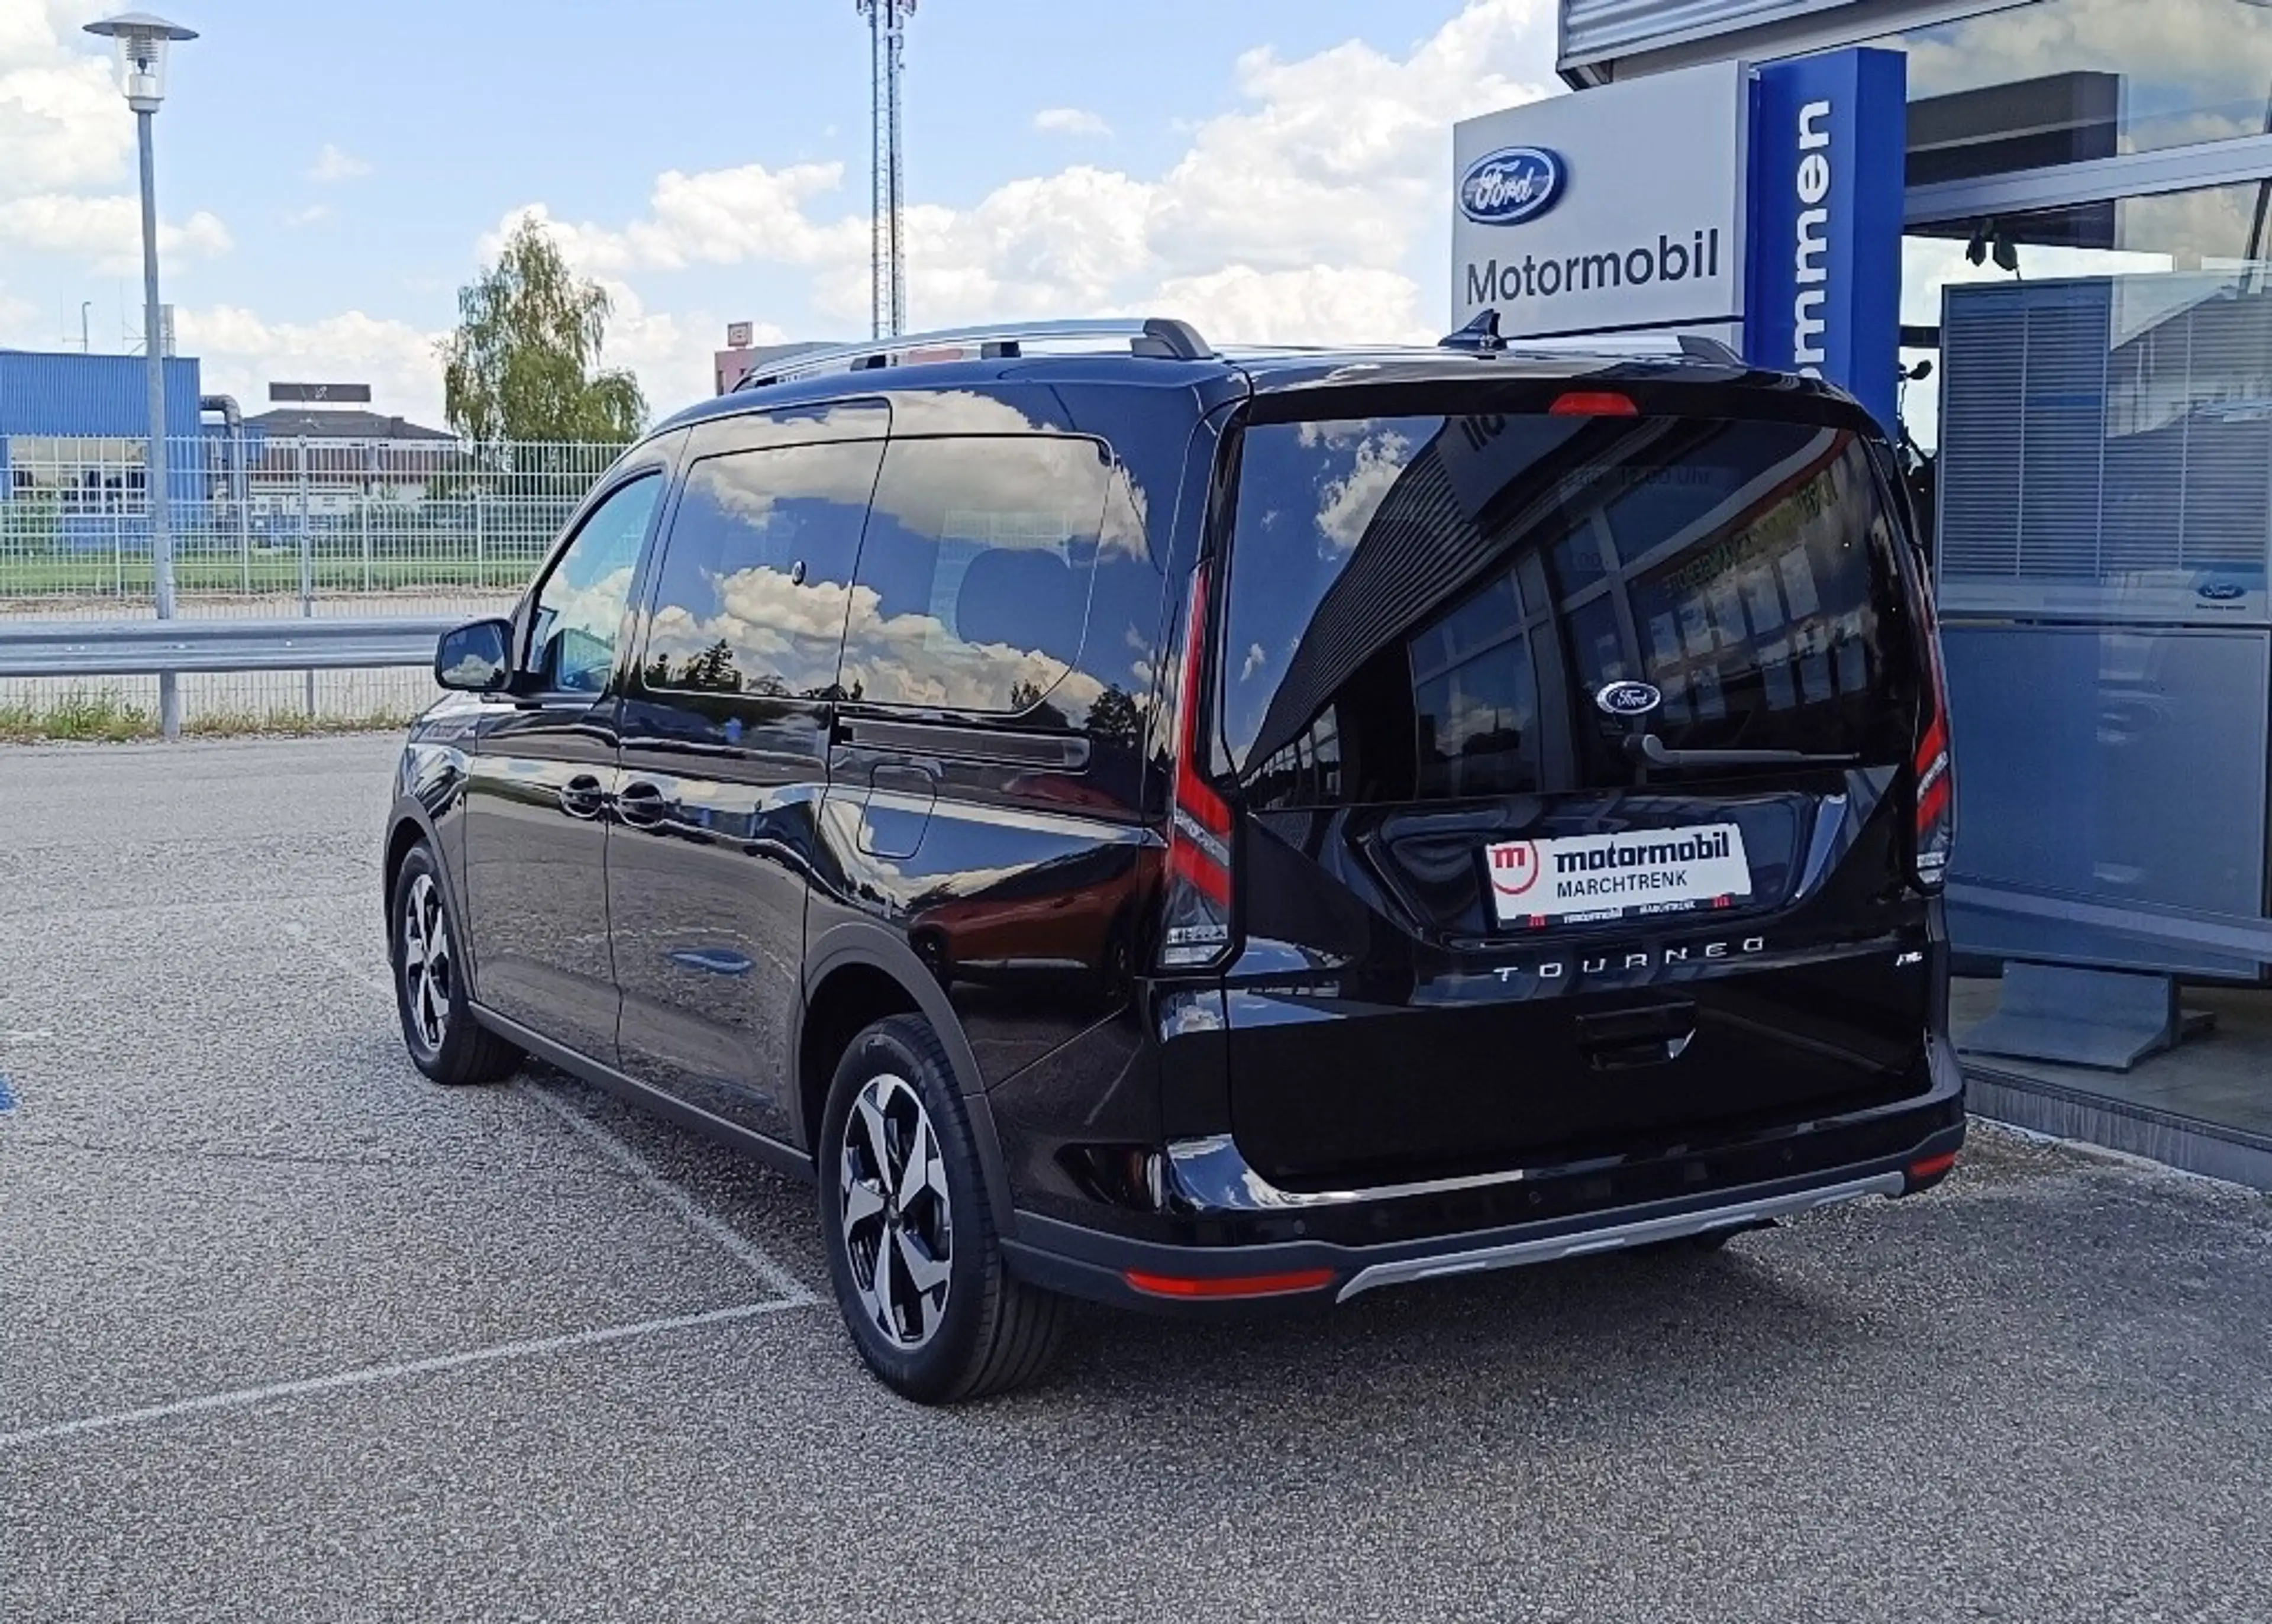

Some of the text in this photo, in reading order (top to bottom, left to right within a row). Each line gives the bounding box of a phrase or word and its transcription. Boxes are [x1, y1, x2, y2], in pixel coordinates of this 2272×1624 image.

[1475, 159, 1534, 210] Ford
[1467, 228, 1718, 306] Motormobil
[1553, 831, 1729, 873] motormobil
[1557, 870, 1688, 899] MARCHTRENK
[1493, 936, 1766, 982] TOURNEO
